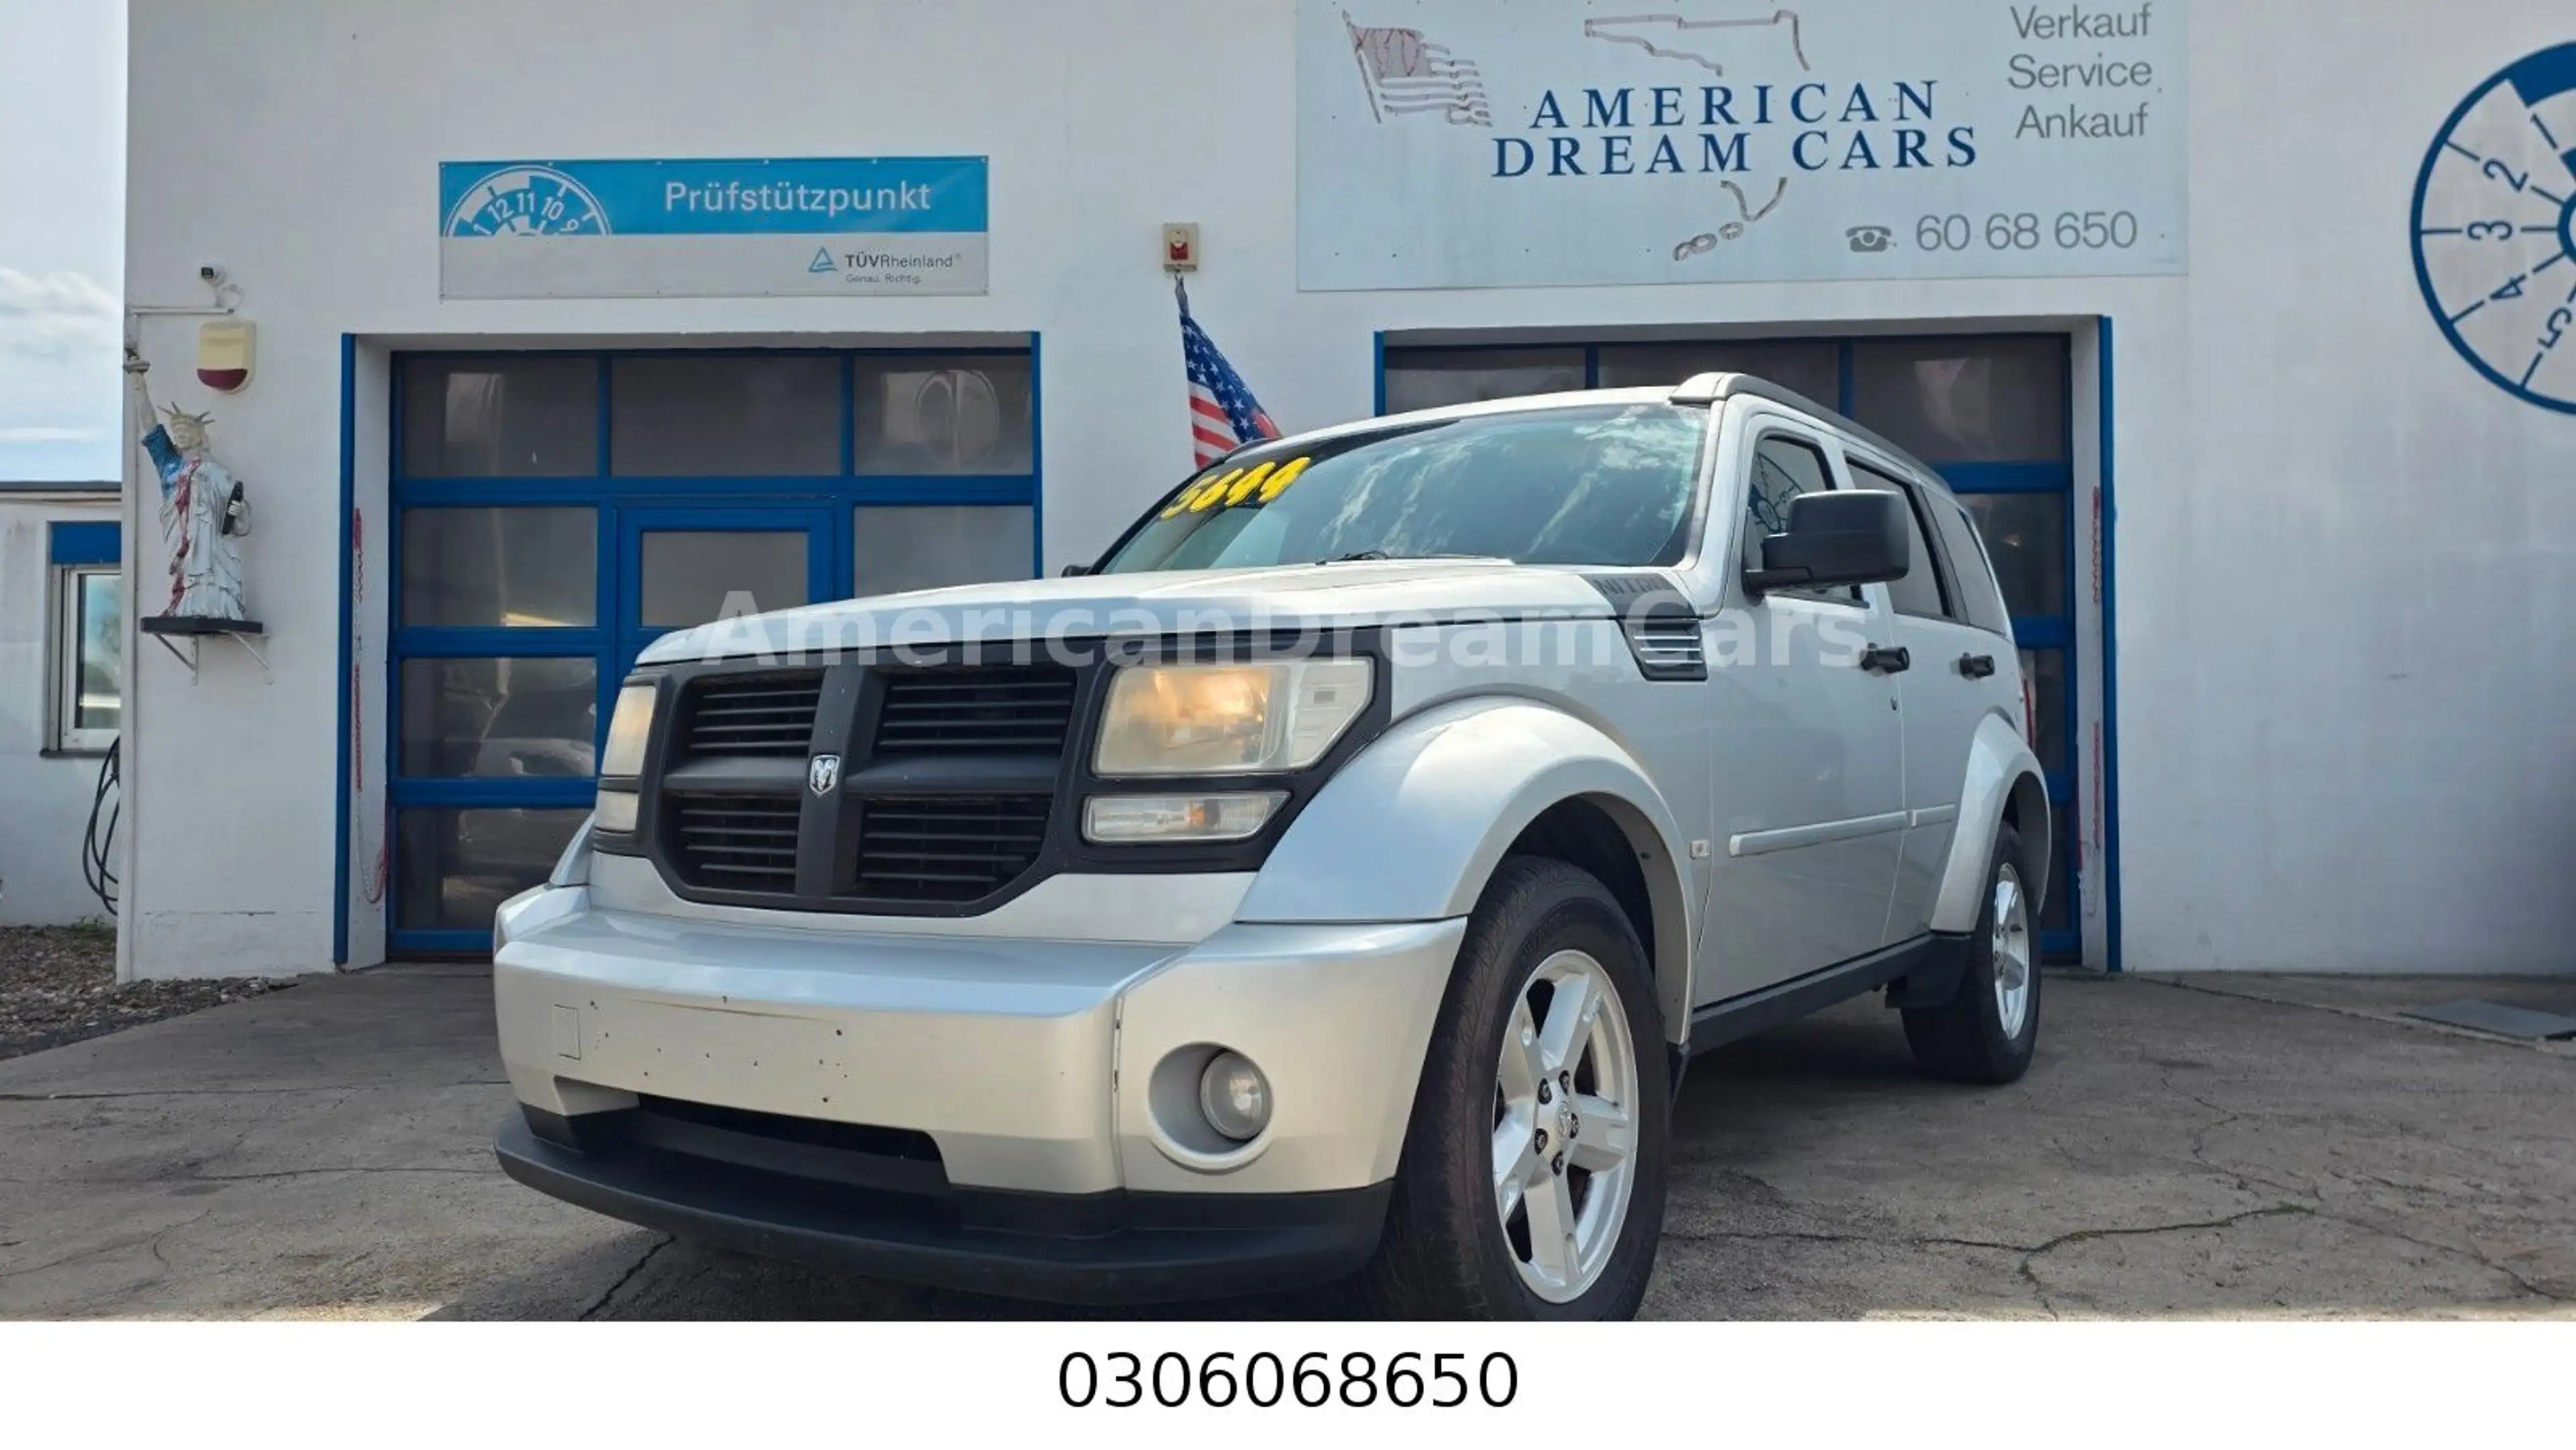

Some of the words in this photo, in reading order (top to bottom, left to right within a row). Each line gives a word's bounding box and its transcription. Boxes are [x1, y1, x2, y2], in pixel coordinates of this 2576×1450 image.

[2010, 3, 2151, 39] Verkauf
[2007, 53, 2152, 89] Service
[1529, 80, 1937, 129] AMERICAN
[2015, 102, 2149, 139] Ankauf
[1491, 132, 1751, 177] DREAM
[1792, 126, 1976, 170] CARS
[2482, 158, 2529, 192] 2
[488, 199, 514, 223] 12
[517, 192, 534, 213] 11
[541, 197, 565, 220] 10
[665, 180, 932, 217] Prüfstützpunkt
[1916, 214, 1970, 251] 60
[1985, 213, 2039, 250] 68
[2054, 211, 2138, 249] 650
[2467, 219, 2513, 241] 3
[2489, 274, 2527, 300] 4
[2536, 306, 2573, 349] 5
